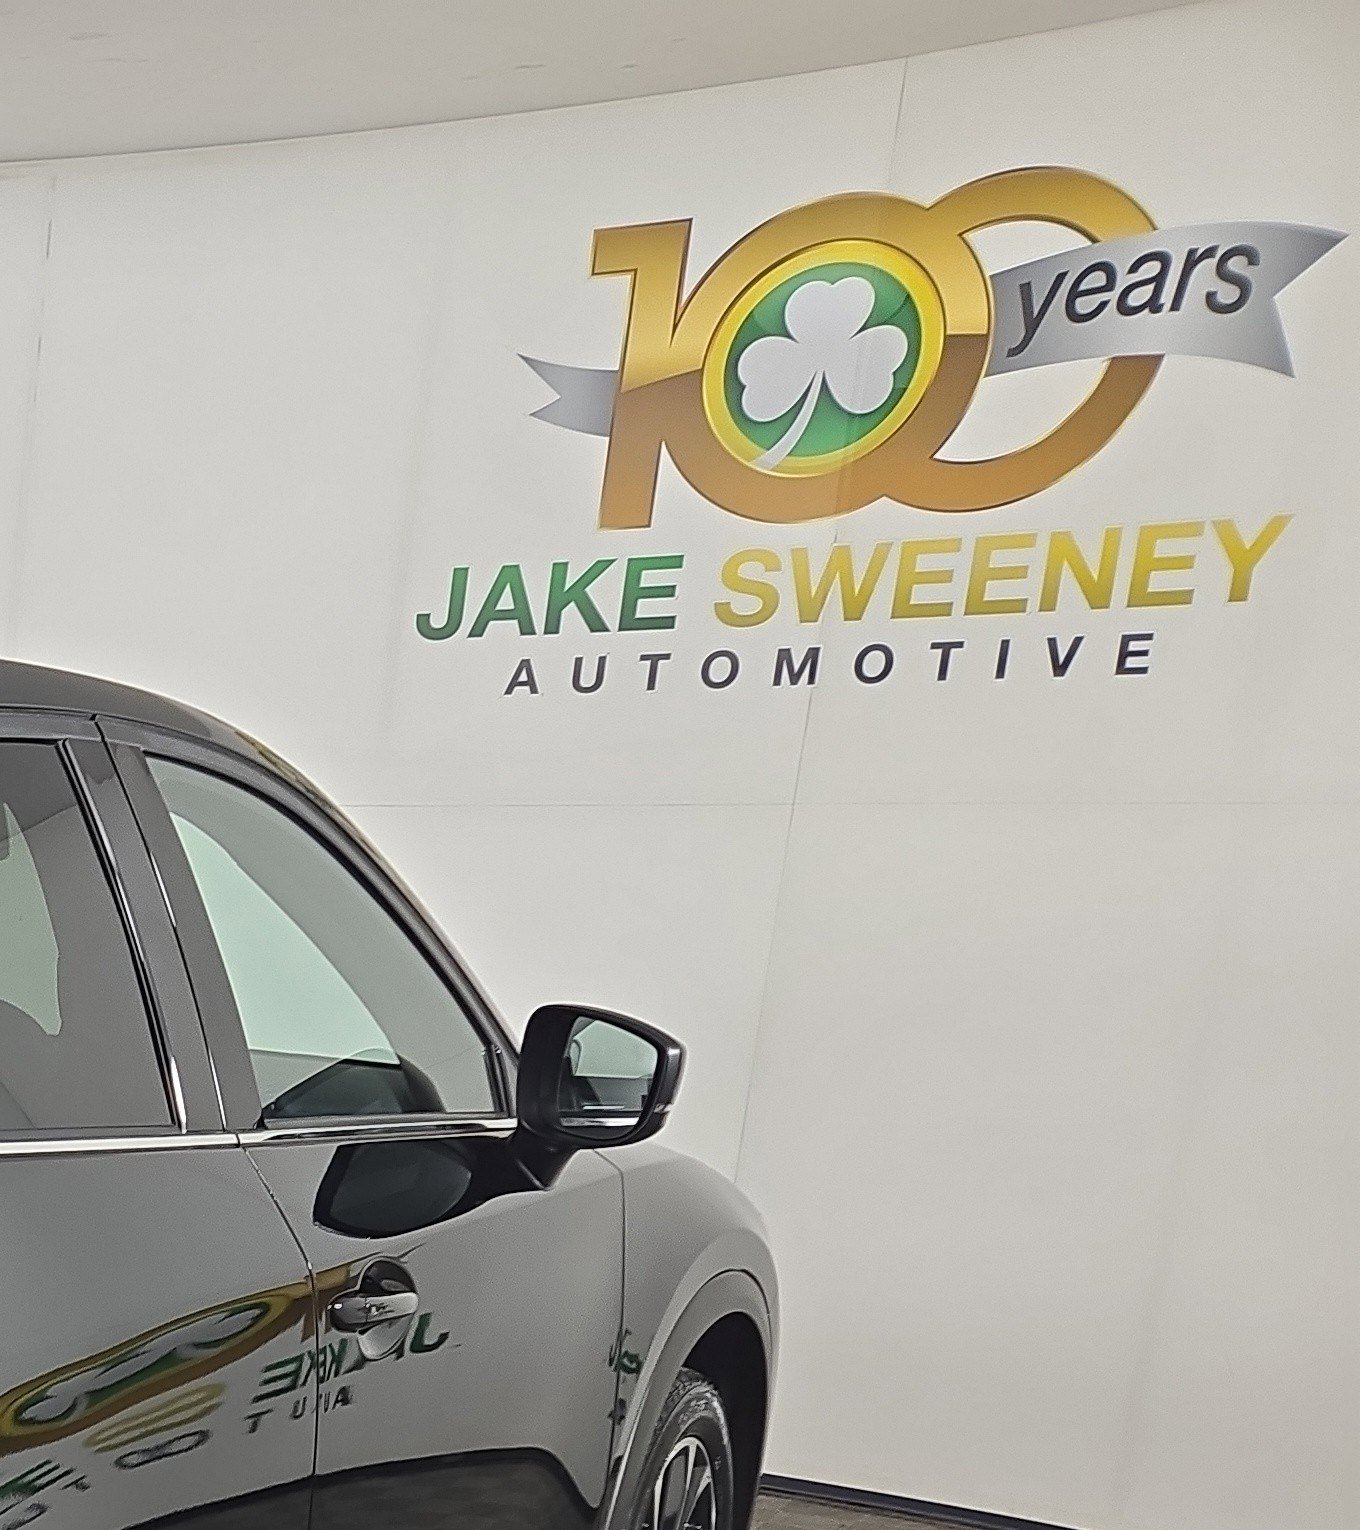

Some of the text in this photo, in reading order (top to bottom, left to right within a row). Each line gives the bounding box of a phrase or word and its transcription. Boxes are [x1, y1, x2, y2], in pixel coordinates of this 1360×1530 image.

[590, 165, 1165, 529] 100
[1005, 242, 1261, 359] years
[415, 513, 1294, 642] JAKE SWEENEY
[505, 632, 1156, 696] AUTOMOTIVE
